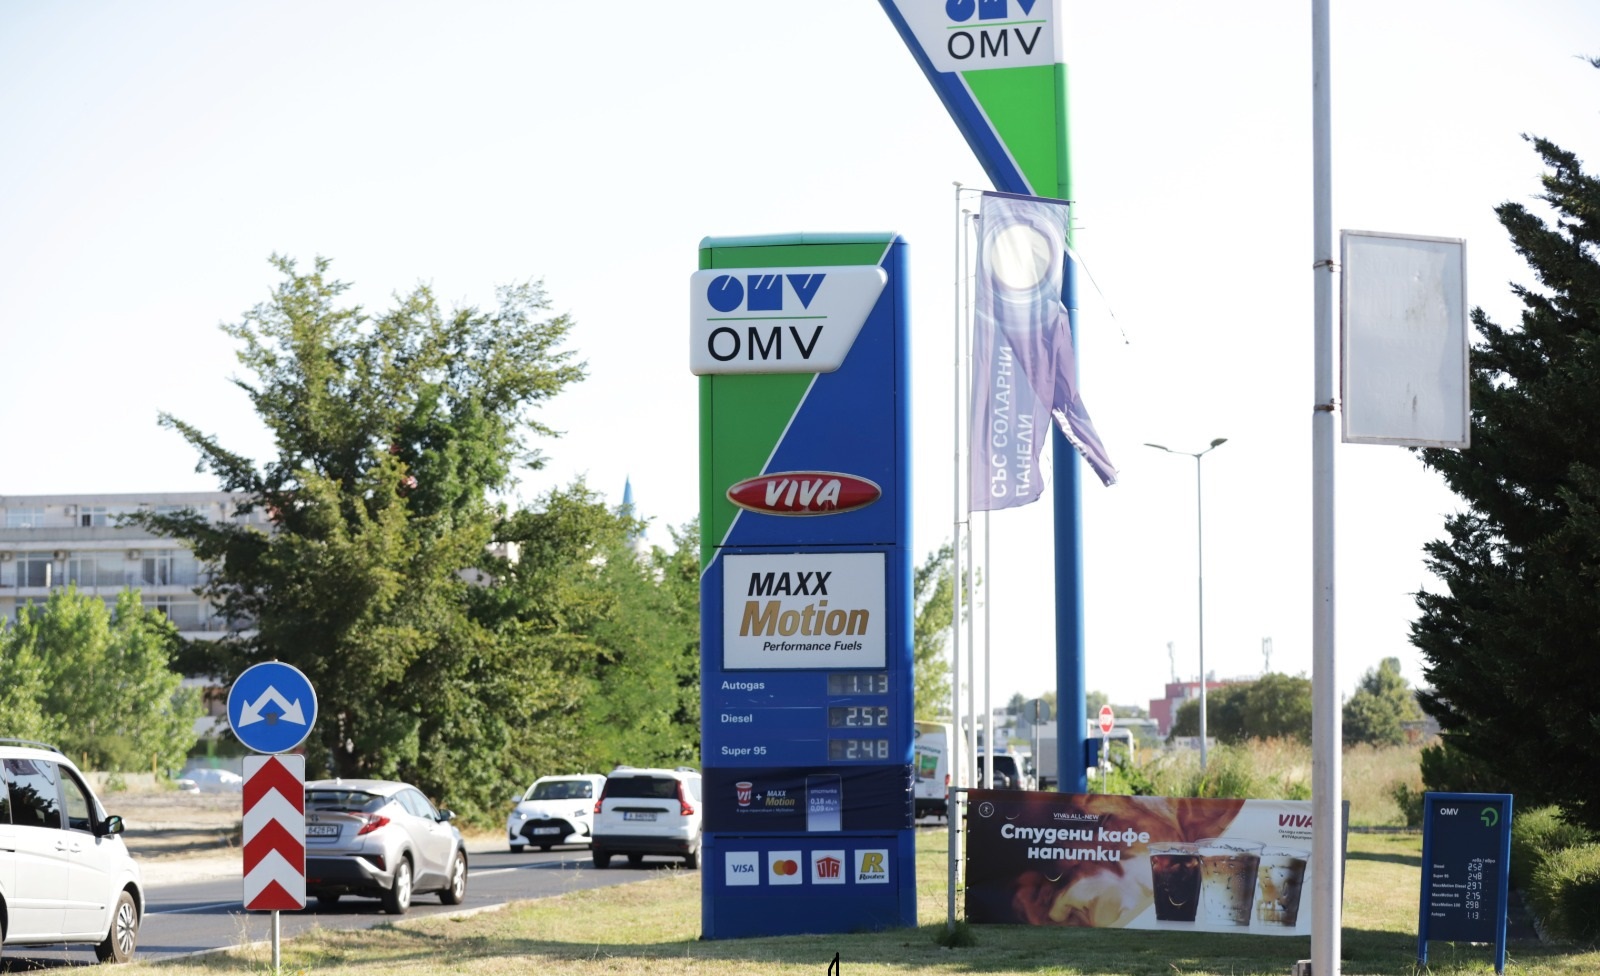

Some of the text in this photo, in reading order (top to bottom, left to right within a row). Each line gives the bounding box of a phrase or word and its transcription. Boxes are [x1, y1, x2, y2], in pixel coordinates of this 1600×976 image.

[947, 26, 1042, 60] OMV
[707, 325, 824, 361] OMV
[991, 346, 1013, 498] СЪС СОЛАРНИ
[1015, 414, 1033, 497] ПАНЕЛИ
[764, 478, 842, 507] VIVA
[747, 571, 832, 597] MAXX
[739, 600, 870, 637] Motion
[763, 640, 863, 652] Performance Fuels
[721, 681, 765, 692] Autogas
[721, 714, 753, 723] Diesel
[721, 746, 751, 757] Super
[753, 746, 767, 756] 95
[765, 797, 795, 807] Motion
[1440, 808, 1459, 816] OMV
[1001, 823, 1150, 847] Студени кафе
[1027, 846, 1121, 862] напитки
[731, 863, 755, 874] VISA
[816, 856, 841, 878] UTA
[859, 873, 885, 881] Routex
